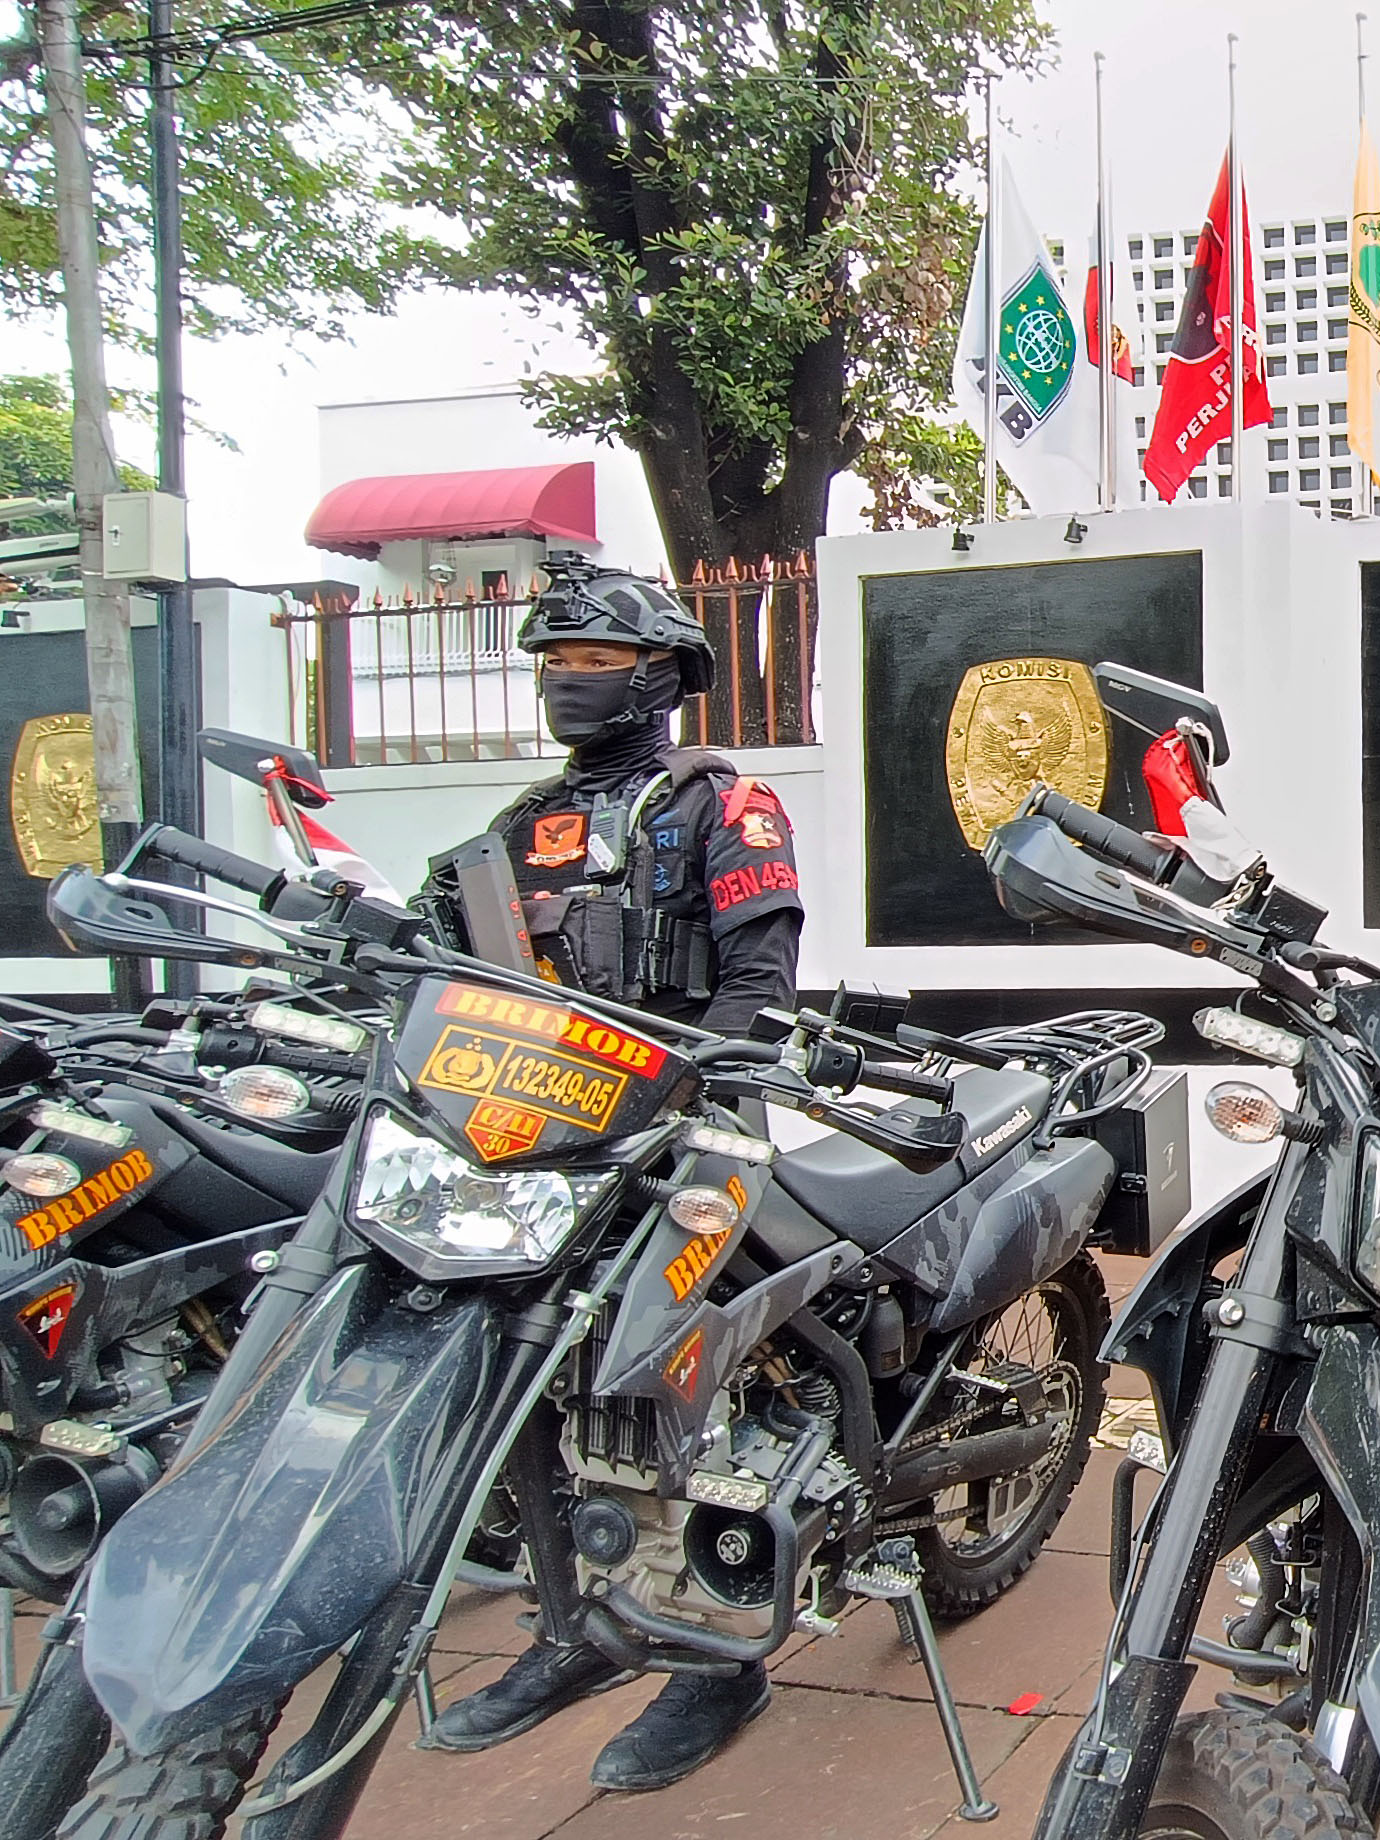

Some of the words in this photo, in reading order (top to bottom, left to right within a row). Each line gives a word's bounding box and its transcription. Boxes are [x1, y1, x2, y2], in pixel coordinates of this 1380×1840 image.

[979, 660, 1072, 682] KOMISI
[710, 866, 762, 912] DEN
[453, 990, 652, 1068] BRIMOB
[501, 1053, 616, 1117] 132349-05
[482, 1133, 512, 1154] 30
[970, 1104, 1034, 1158] Kawasaki
[16, 1149, 154, 1250] BRIMOB
[664, 1174, 748, 1302] BRIB
